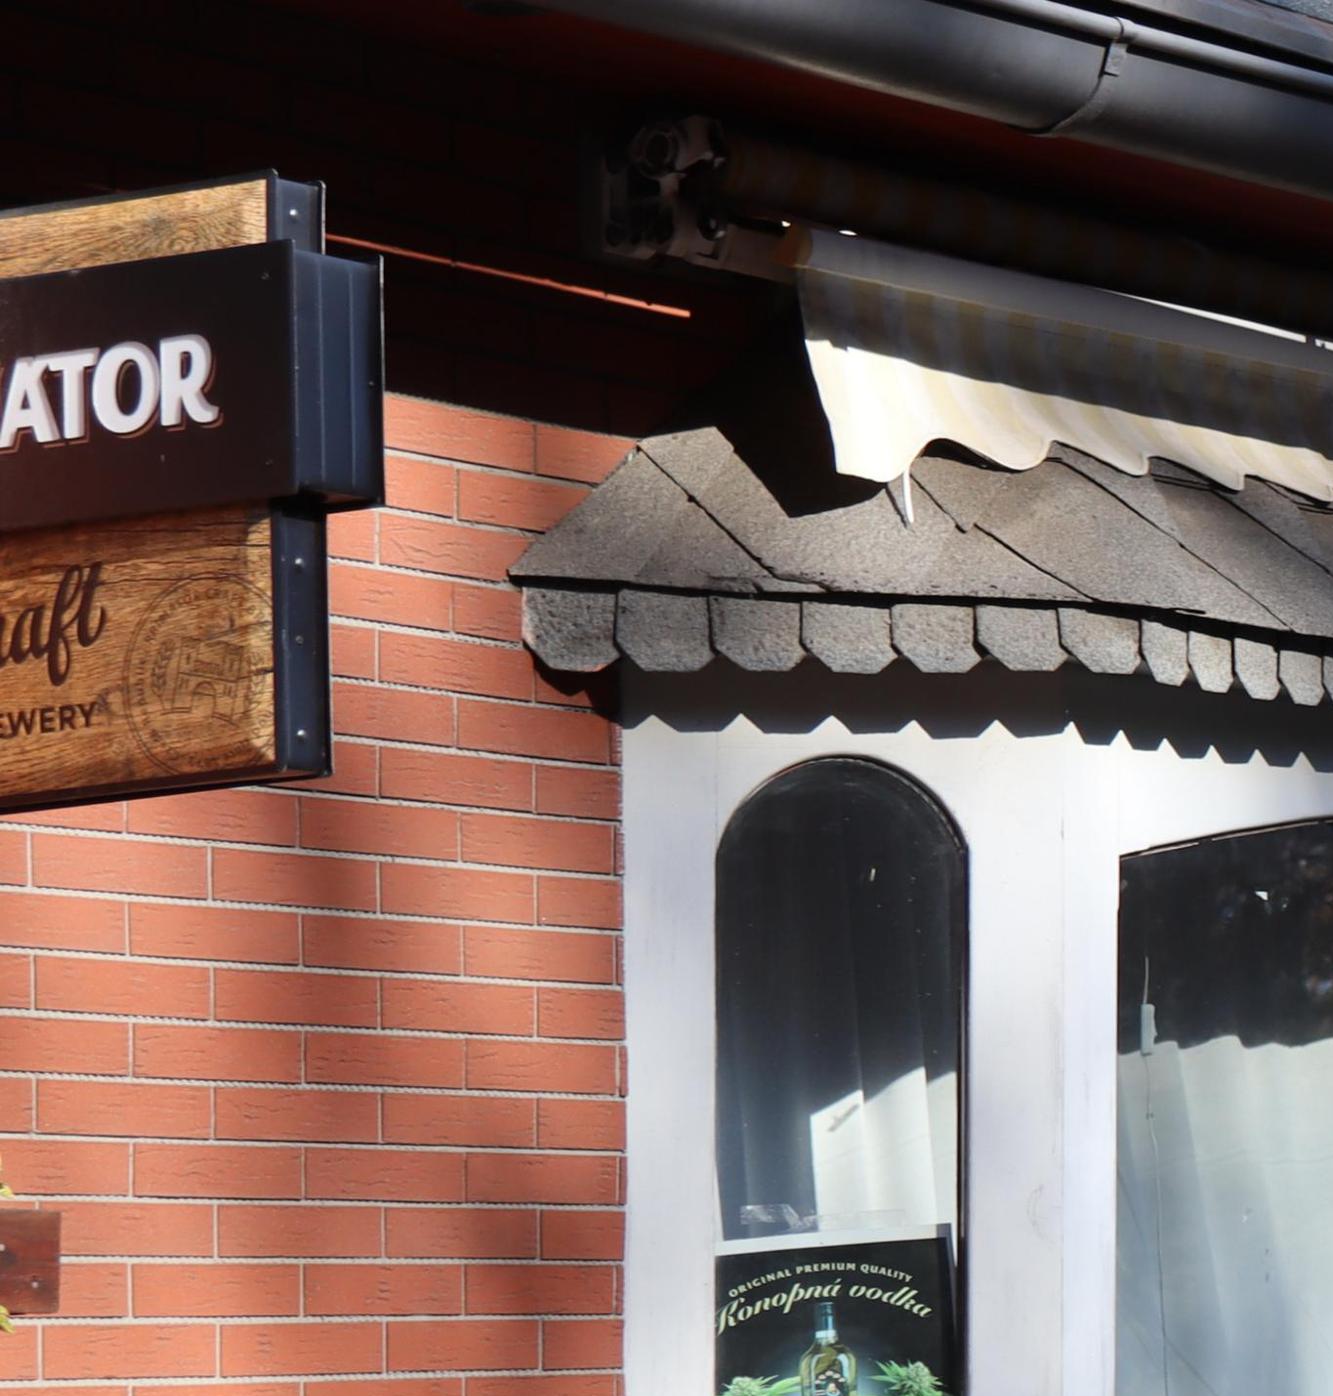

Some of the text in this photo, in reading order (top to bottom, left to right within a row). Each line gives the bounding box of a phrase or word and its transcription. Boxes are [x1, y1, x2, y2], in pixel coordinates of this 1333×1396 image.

[728, 1262, 913, 1298] ORIGINAL PREMIUM QUALITY
[715, 1278, 933, 1337] Konopná vodka
